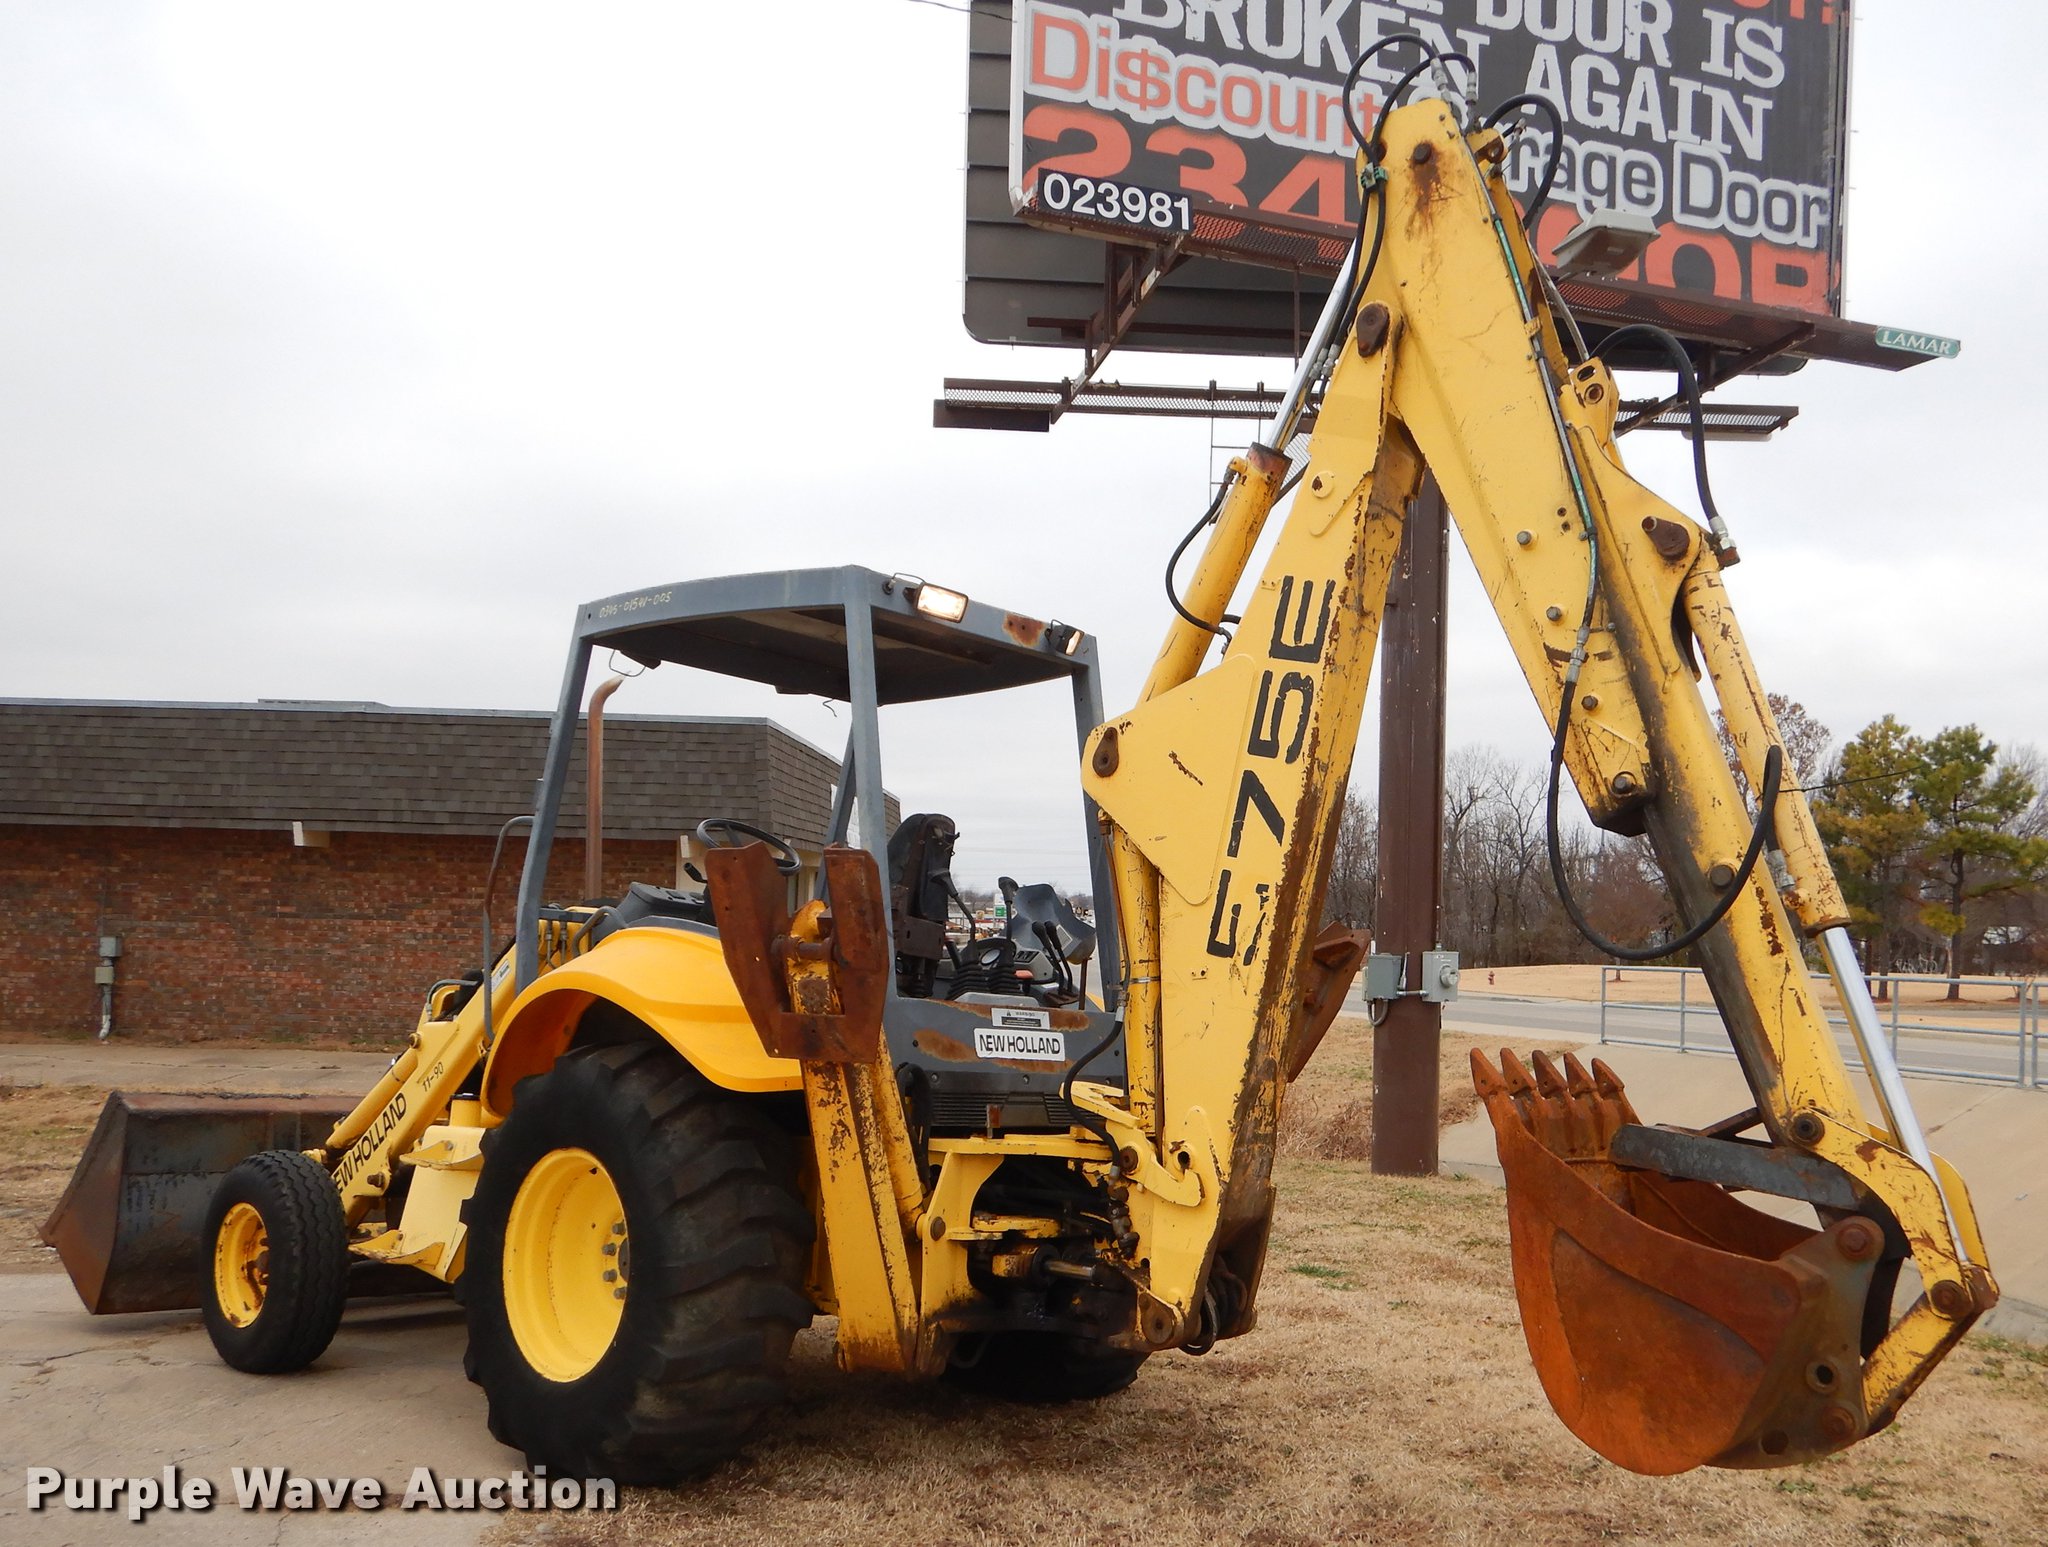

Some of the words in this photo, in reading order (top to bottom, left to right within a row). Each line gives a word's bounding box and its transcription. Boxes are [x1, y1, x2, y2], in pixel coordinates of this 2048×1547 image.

[1112, 0, 1490, 103] ROKEN
[1521, 43, 1773, 161] AGAIN
[1701, 9, 1785, 89] IS
[1044, 173, 1191, 231] 023981
[1680, 150, 1829, 238] Door
[1882, 331, 1951, 354] LAMAR
[1206, 575, 1337, 967] 575E
[979, 1034, 1006, 1052] NEW
[1008, 1036, 1061, 1055] HOLLAND
[333, 1155, 354, 1195] EW
[352, 1092, 407, 1173] HOLLAND
